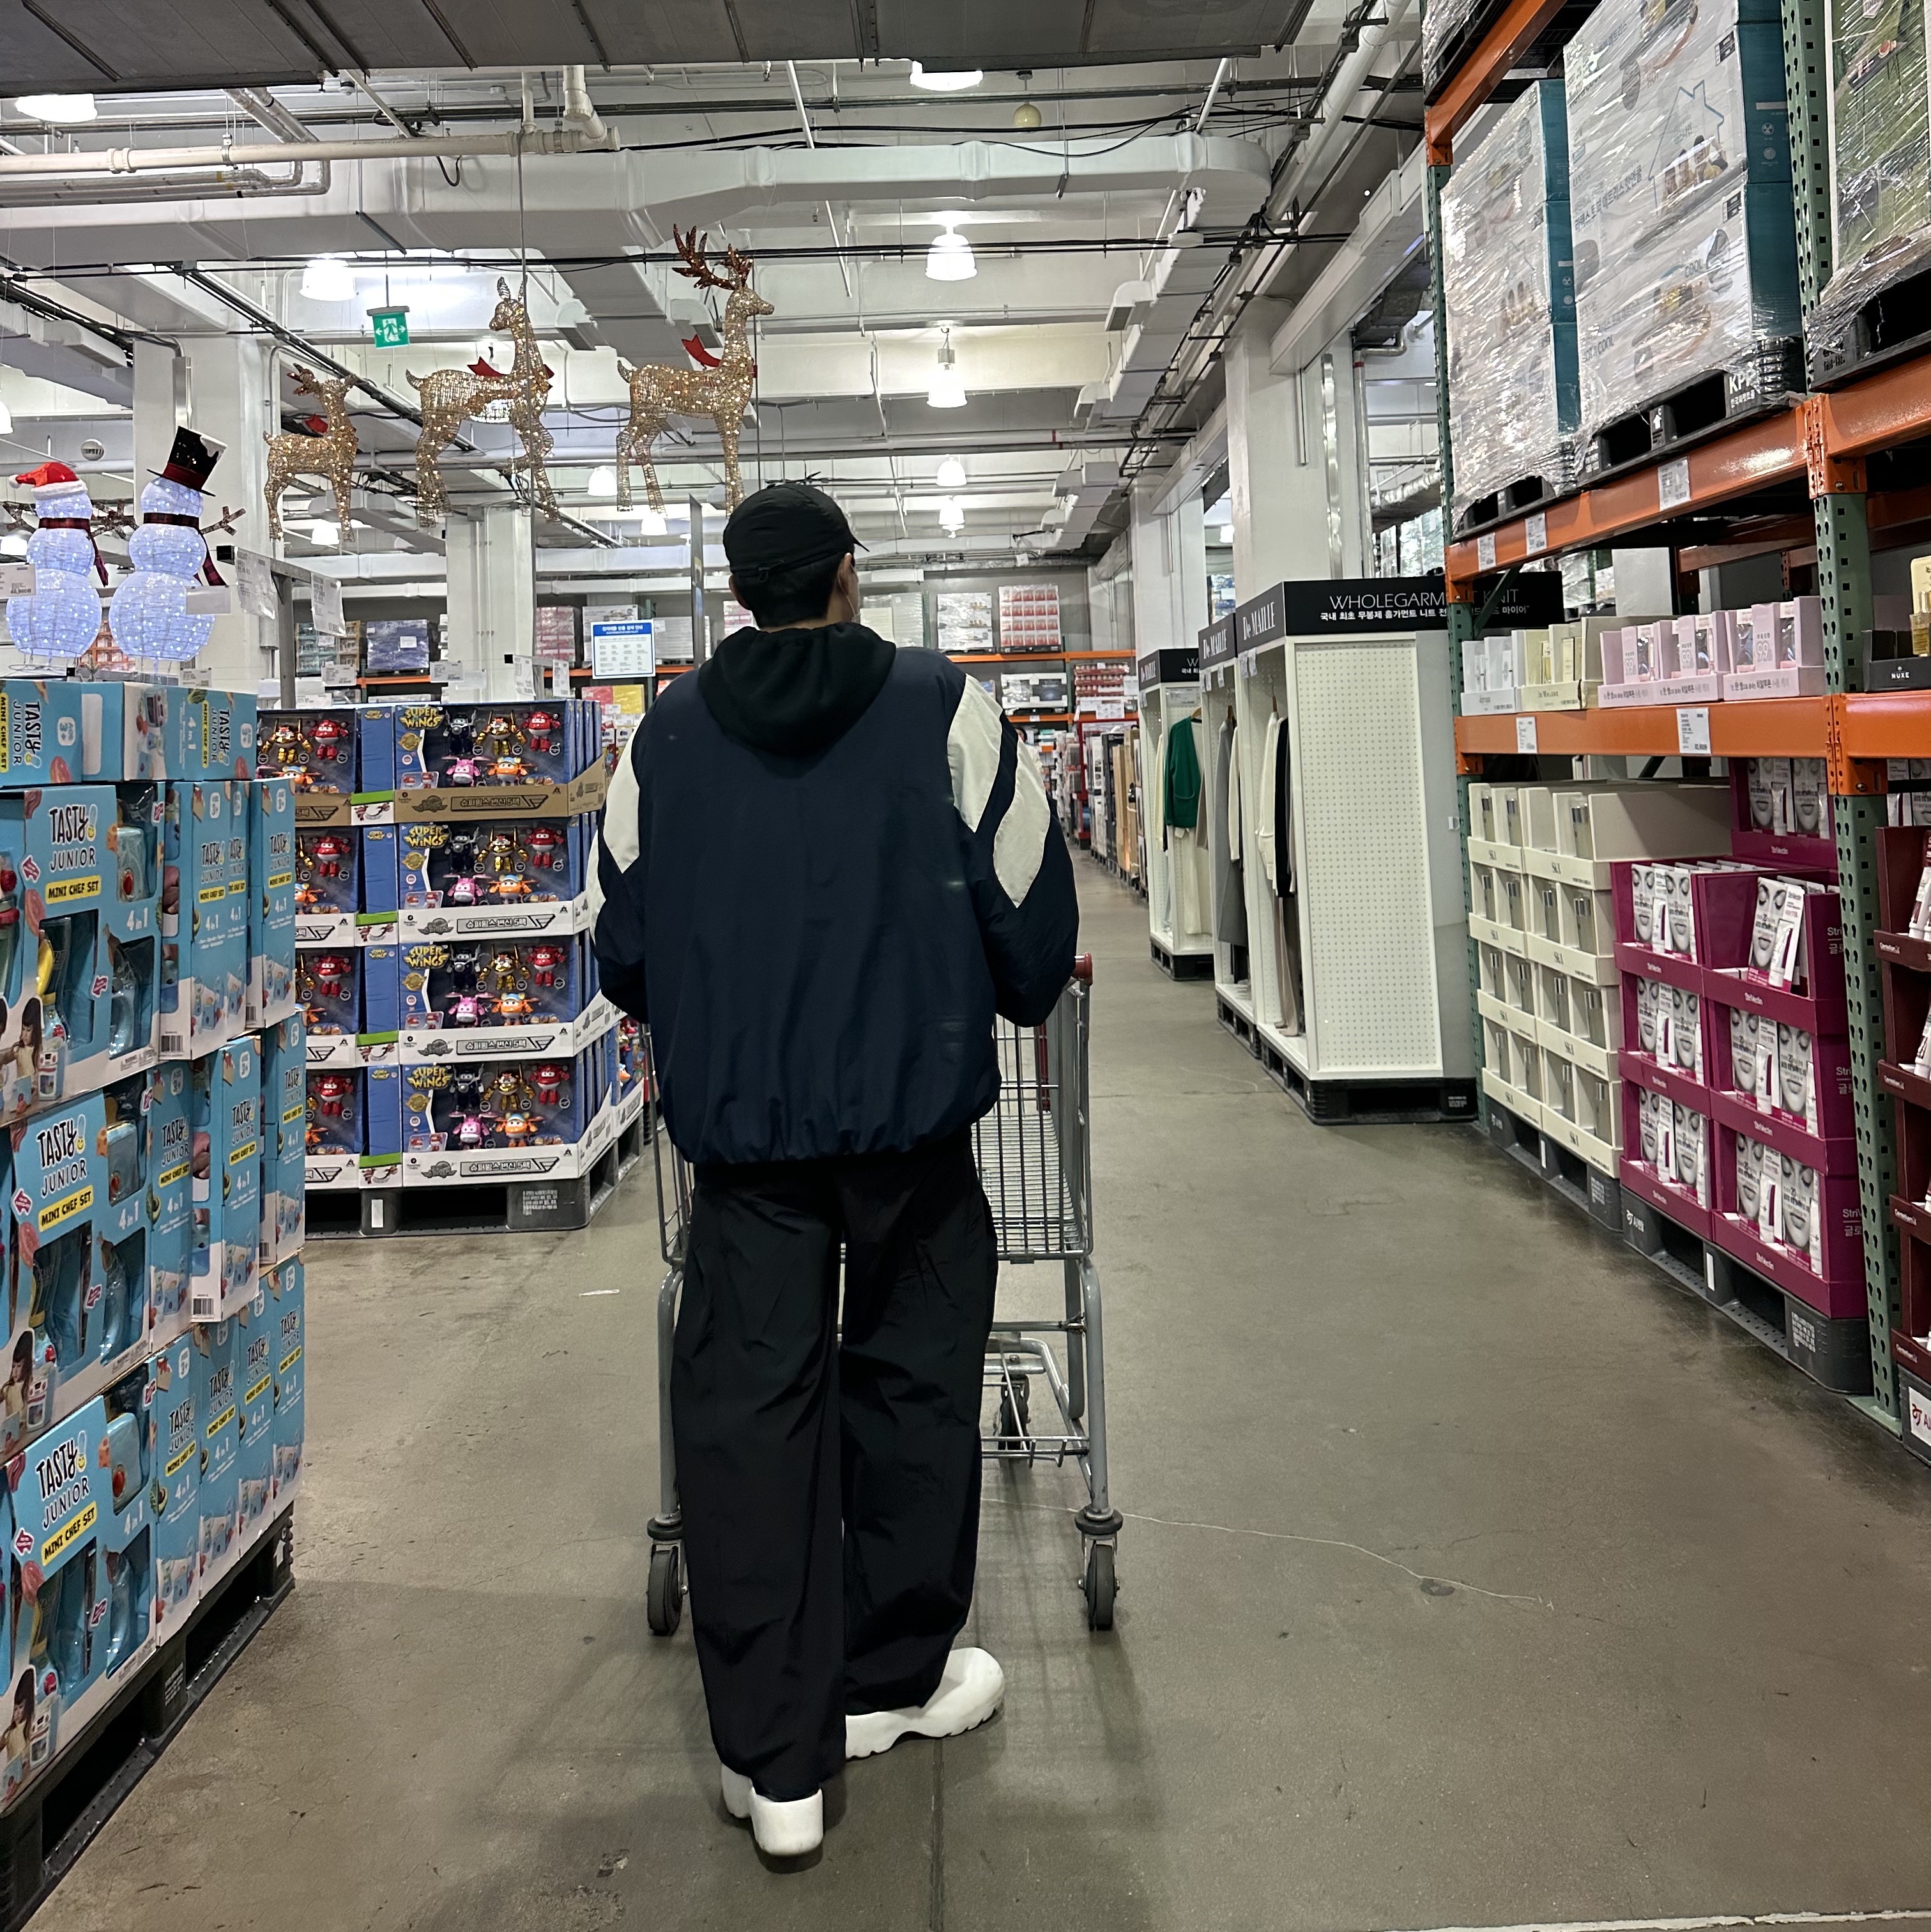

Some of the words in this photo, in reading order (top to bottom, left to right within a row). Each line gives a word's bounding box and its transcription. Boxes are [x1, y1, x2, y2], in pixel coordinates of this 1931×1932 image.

[1685, 259, 1703, 278] COOL
[1242, 617, 1251, 640] De
[1251, 601, 1276, 637] MAILLE
[1320, 612, 1336, 621] 국내
[1339, 611, 1355, 620] 최초
[1358, 611, 1382, 620] 무봉제
[1385, 610, 1417, 619] 홀가먼트
[1419, 609, 1435, 617] 니트
[1203, 639, 1210, 659] De
[1210, 628, 1227, 657] MAILLE
[404, 707, 438, 719] SUPER
[13, 701, 22, 765] JUNIOR
[26, 701, 41, 755] TASTY
[219, 709, 230, 754] TASTY
[460, 798, 491, 807] 슈퍼윙스
[50, 806, 89, 843] TASTY
[409, 825, 443, 837] SUPER
[50, 847, 95, 871] JUNIOR
[201, 842, 220, 866] TASTY
[270, 833, 287, 857] TASTY
[201, 869, 224, 884] JUNIOR
[270, 856, 290, 872] JUNIOR
[48, 885, 66, 899] MINI
[69, 883, 85, 895] CHEF
[87, 880, 99, 892] SET
[466, 919, 496, 928] 슈퍼윙스
[497, 918, 512, 928] 변신
[514, 917, 527, 926] 5팩
[409, 946, 444, 957] SUPER
[466, 1041, 496, 1050] 슈퍼윙스
[496, 1039, 512, 1049] 변신
[513, 1039, 527, 1048] 5팩
[285, 1066, 300, 1090] TASTY
[413, 1066, 448, 1077] SUPER
[232, 1100, 252, 1128] TASTY
[37, 1119, 77, 1168] TASTY
[162, 1118, 185, 1147] TASTY
[232, 1124, 254, 1145] JUNIOR
[162, 1144, 190, 1167] JUNIOR
[469, 1163, 500, 1172] 슈퍼윙스
[501, 1162, 516, 1171] 변신
[517, 1161, 531, 1170] 5팩
[42, 1159, 87, 1197] JUNIOR
[160, 1171, 172, 1184] MINI
[172, 1167, 183, 1179] CHEF
[41, 1207, 60, 1225] MINI
[62, 1197, 78, 1215] CHEF
[79, 1190, 91, 1206] SET
[281, 1310, 297, 1338] TASTY
[247, 1336, 266, 1369] TASTY
[210, 1365, 230, 1399] TASTY
[247, 1357, 269, 1386] JUNIOR
[210, 1388, 233, 1417] JUNIOR
[169, 1400, 191, 1435] TASTY
[169, 1423, 194, 1454] JUNIOR
[36, 1439, 78, 1499] TASTY
[43, 1477, 89, 1529] JUNIOR
[45, 1533, 63, 1560] MINI
[65, 1520, 81, 1542] CHEF
[83, 1506, 95, 1527] SET
